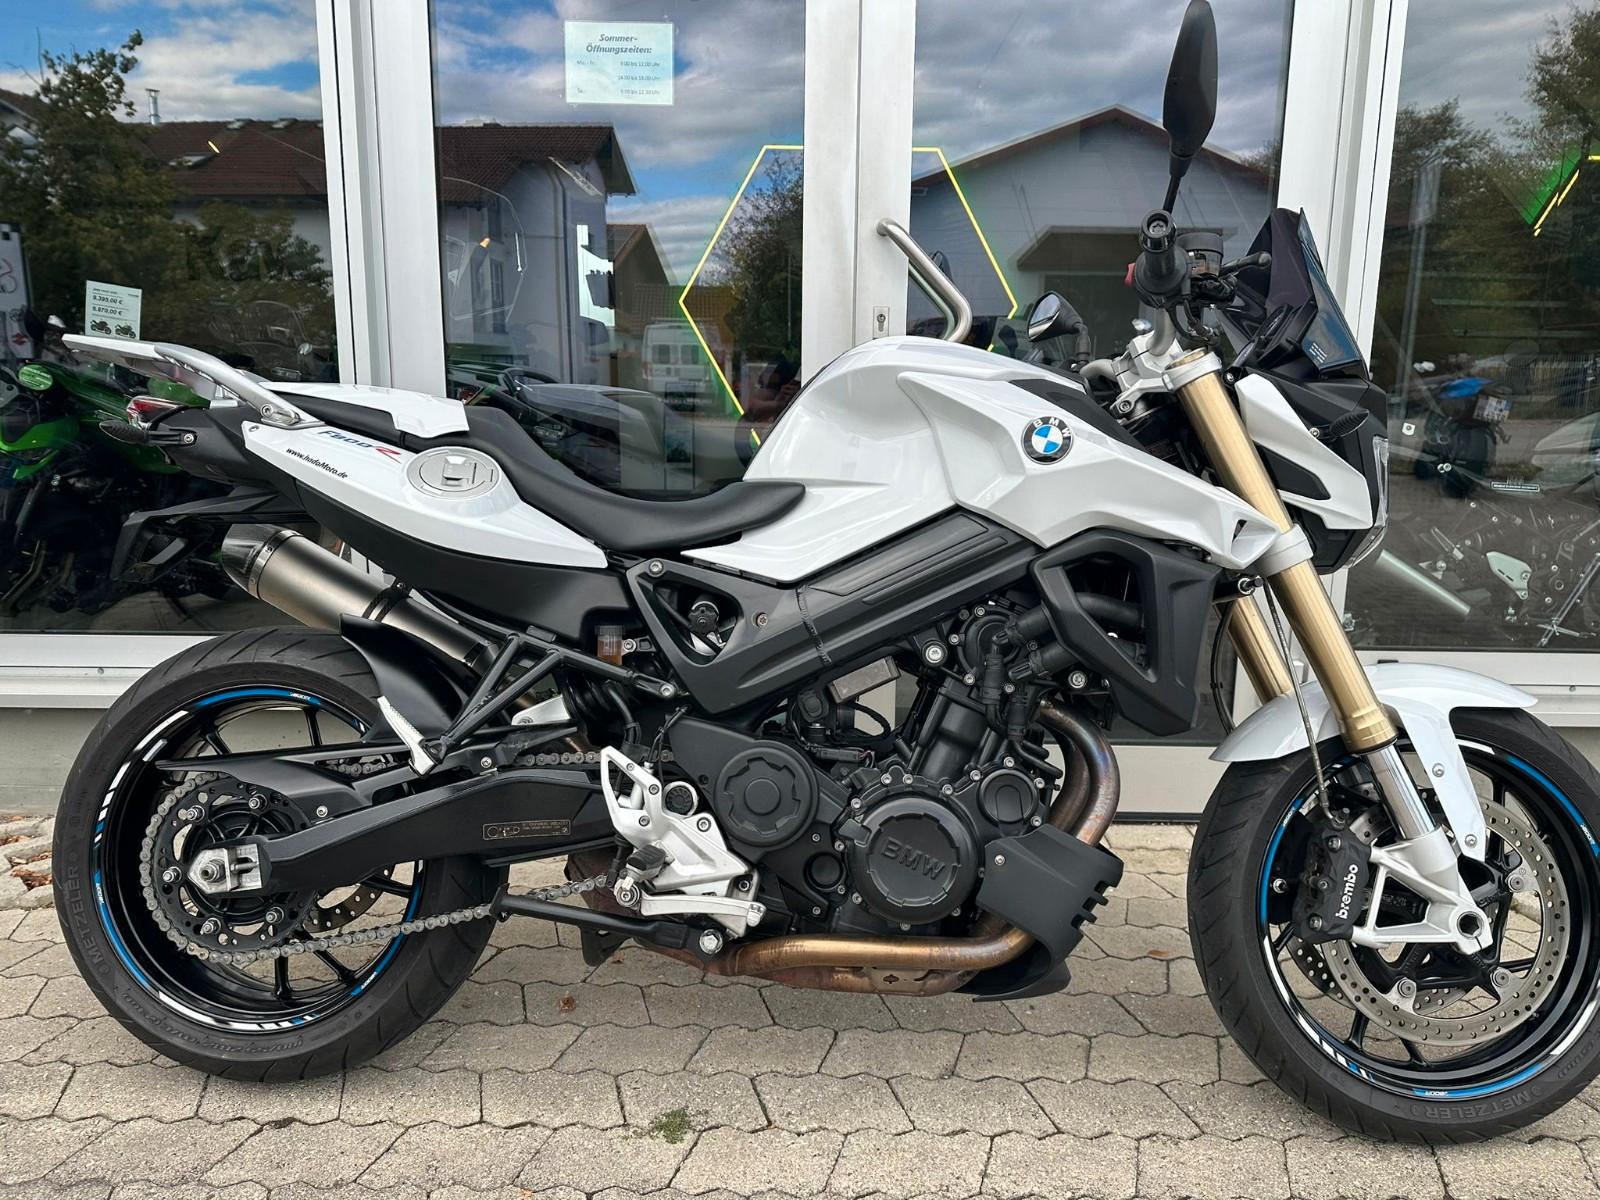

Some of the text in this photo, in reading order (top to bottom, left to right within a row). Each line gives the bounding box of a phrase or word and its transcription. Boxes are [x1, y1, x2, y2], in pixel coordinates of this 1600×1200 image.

[585, 43, 653, 55] Öffnungszeiten:
[599, 33, 638, 42] Sommer-
[1032, 417, 1071, 438] BMW
[881, 836, 945, 881] BMW
[1335, 864, 1359, 919] brembo
[68, 866, 104, 963] METZELER
[1424, 1090, 1536, 1119] METZELER
